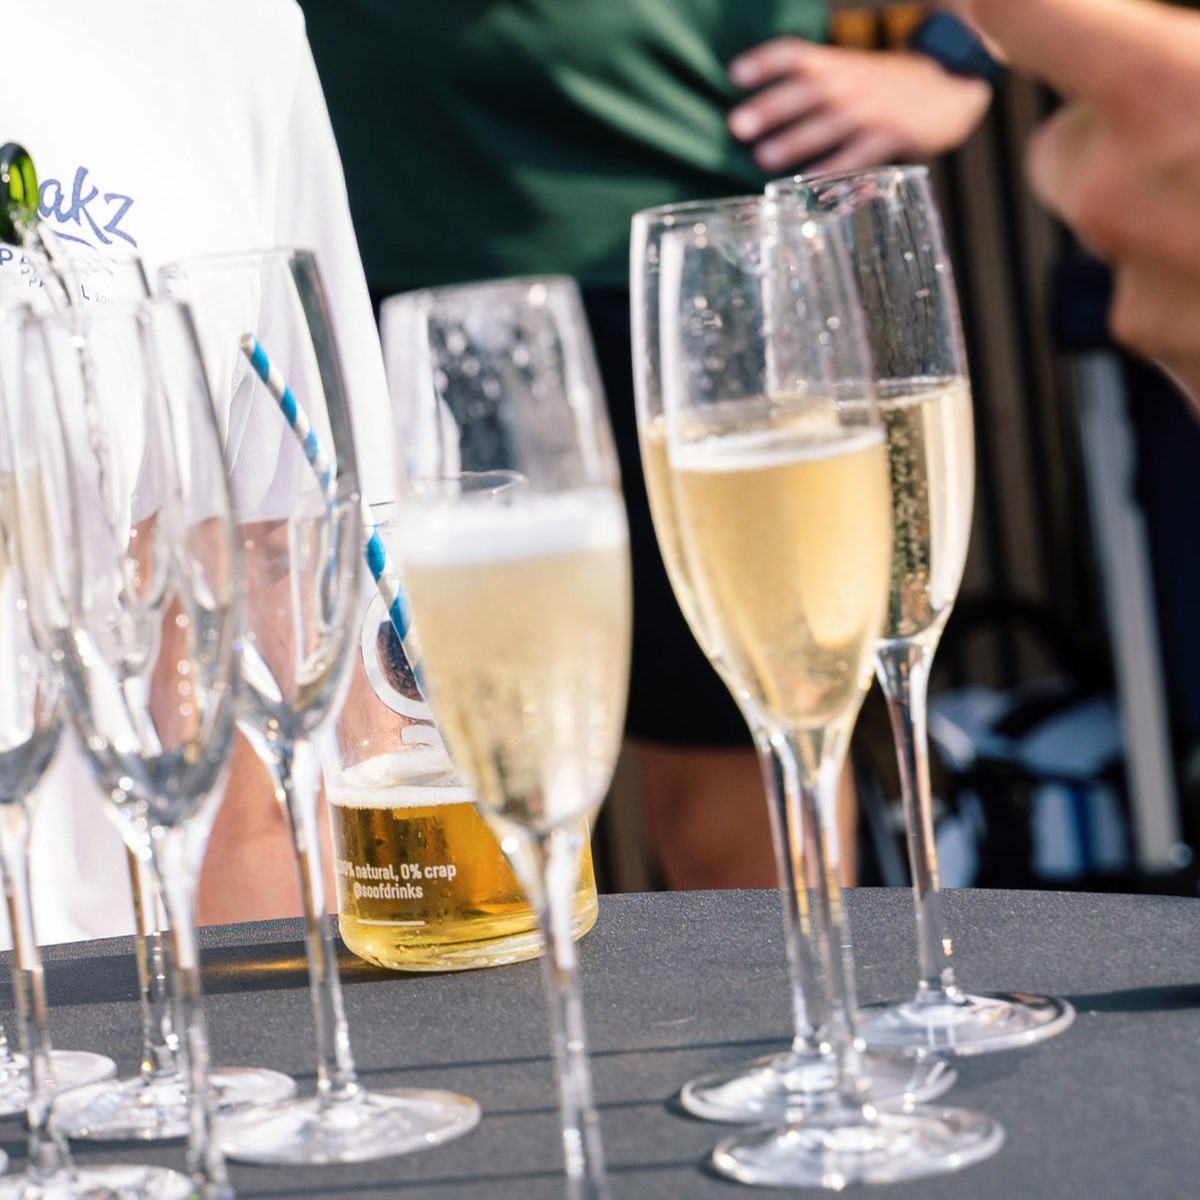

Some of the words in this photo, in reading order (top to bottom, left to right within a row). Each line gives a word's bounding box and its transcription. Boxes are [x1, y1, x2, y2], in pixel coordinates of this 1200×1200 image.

[38, 166, 138, 249] akz
[355, 863, 399, 881] natural,
[401, 863, 421, 880] 0%
[424, 864, 457, 881] crap
[353, 881, 424, 899] @soofdrinks
